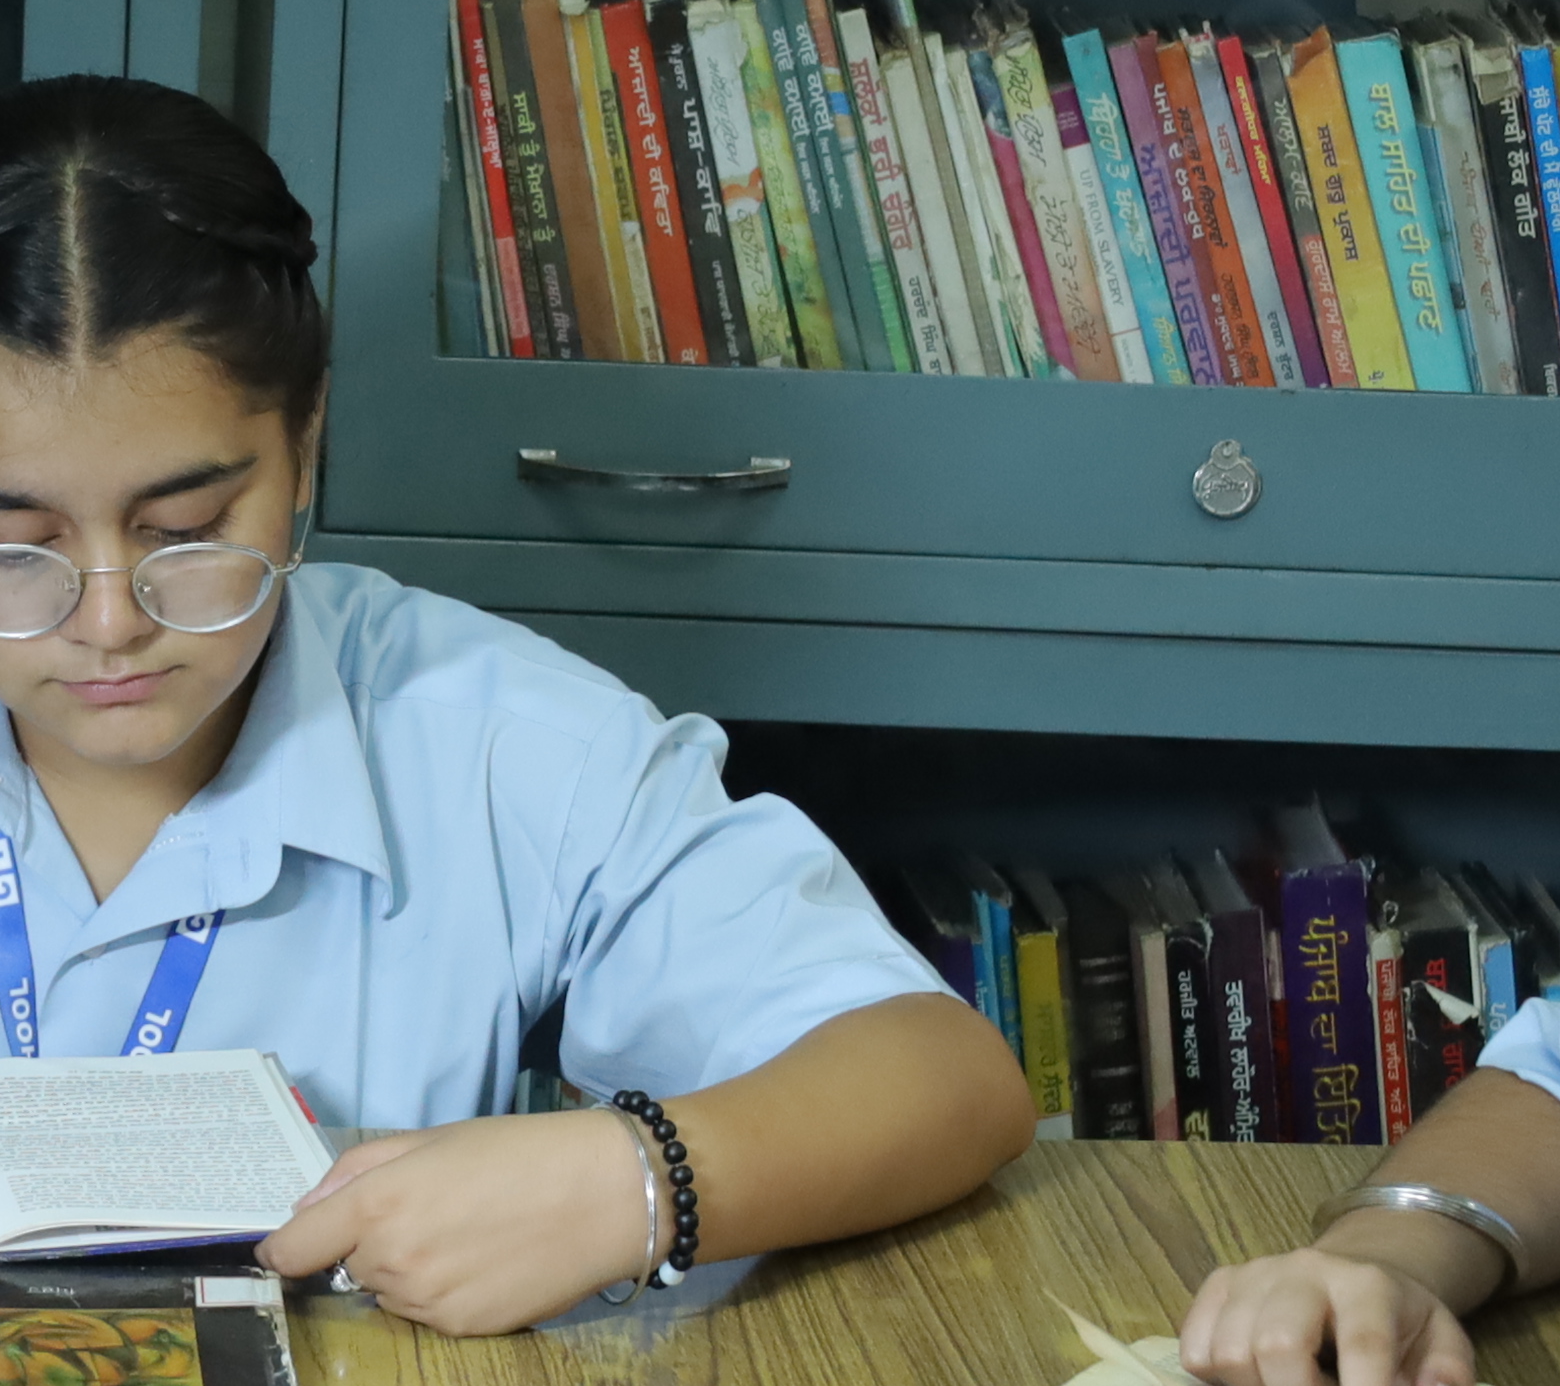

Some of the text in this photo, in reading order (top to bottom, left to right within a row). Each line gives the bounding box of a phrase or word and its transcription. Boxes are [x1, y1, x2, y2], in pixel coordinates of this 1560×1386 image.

[641, 134, 659, 160] ਦੀ
[1079, 170, 1124, 307] UP FROM SLAVERY
[1400, 223, 1426, 252] ਦੀ
[1299, 915, 1349, 1004] ਪੰਜਾਬ
